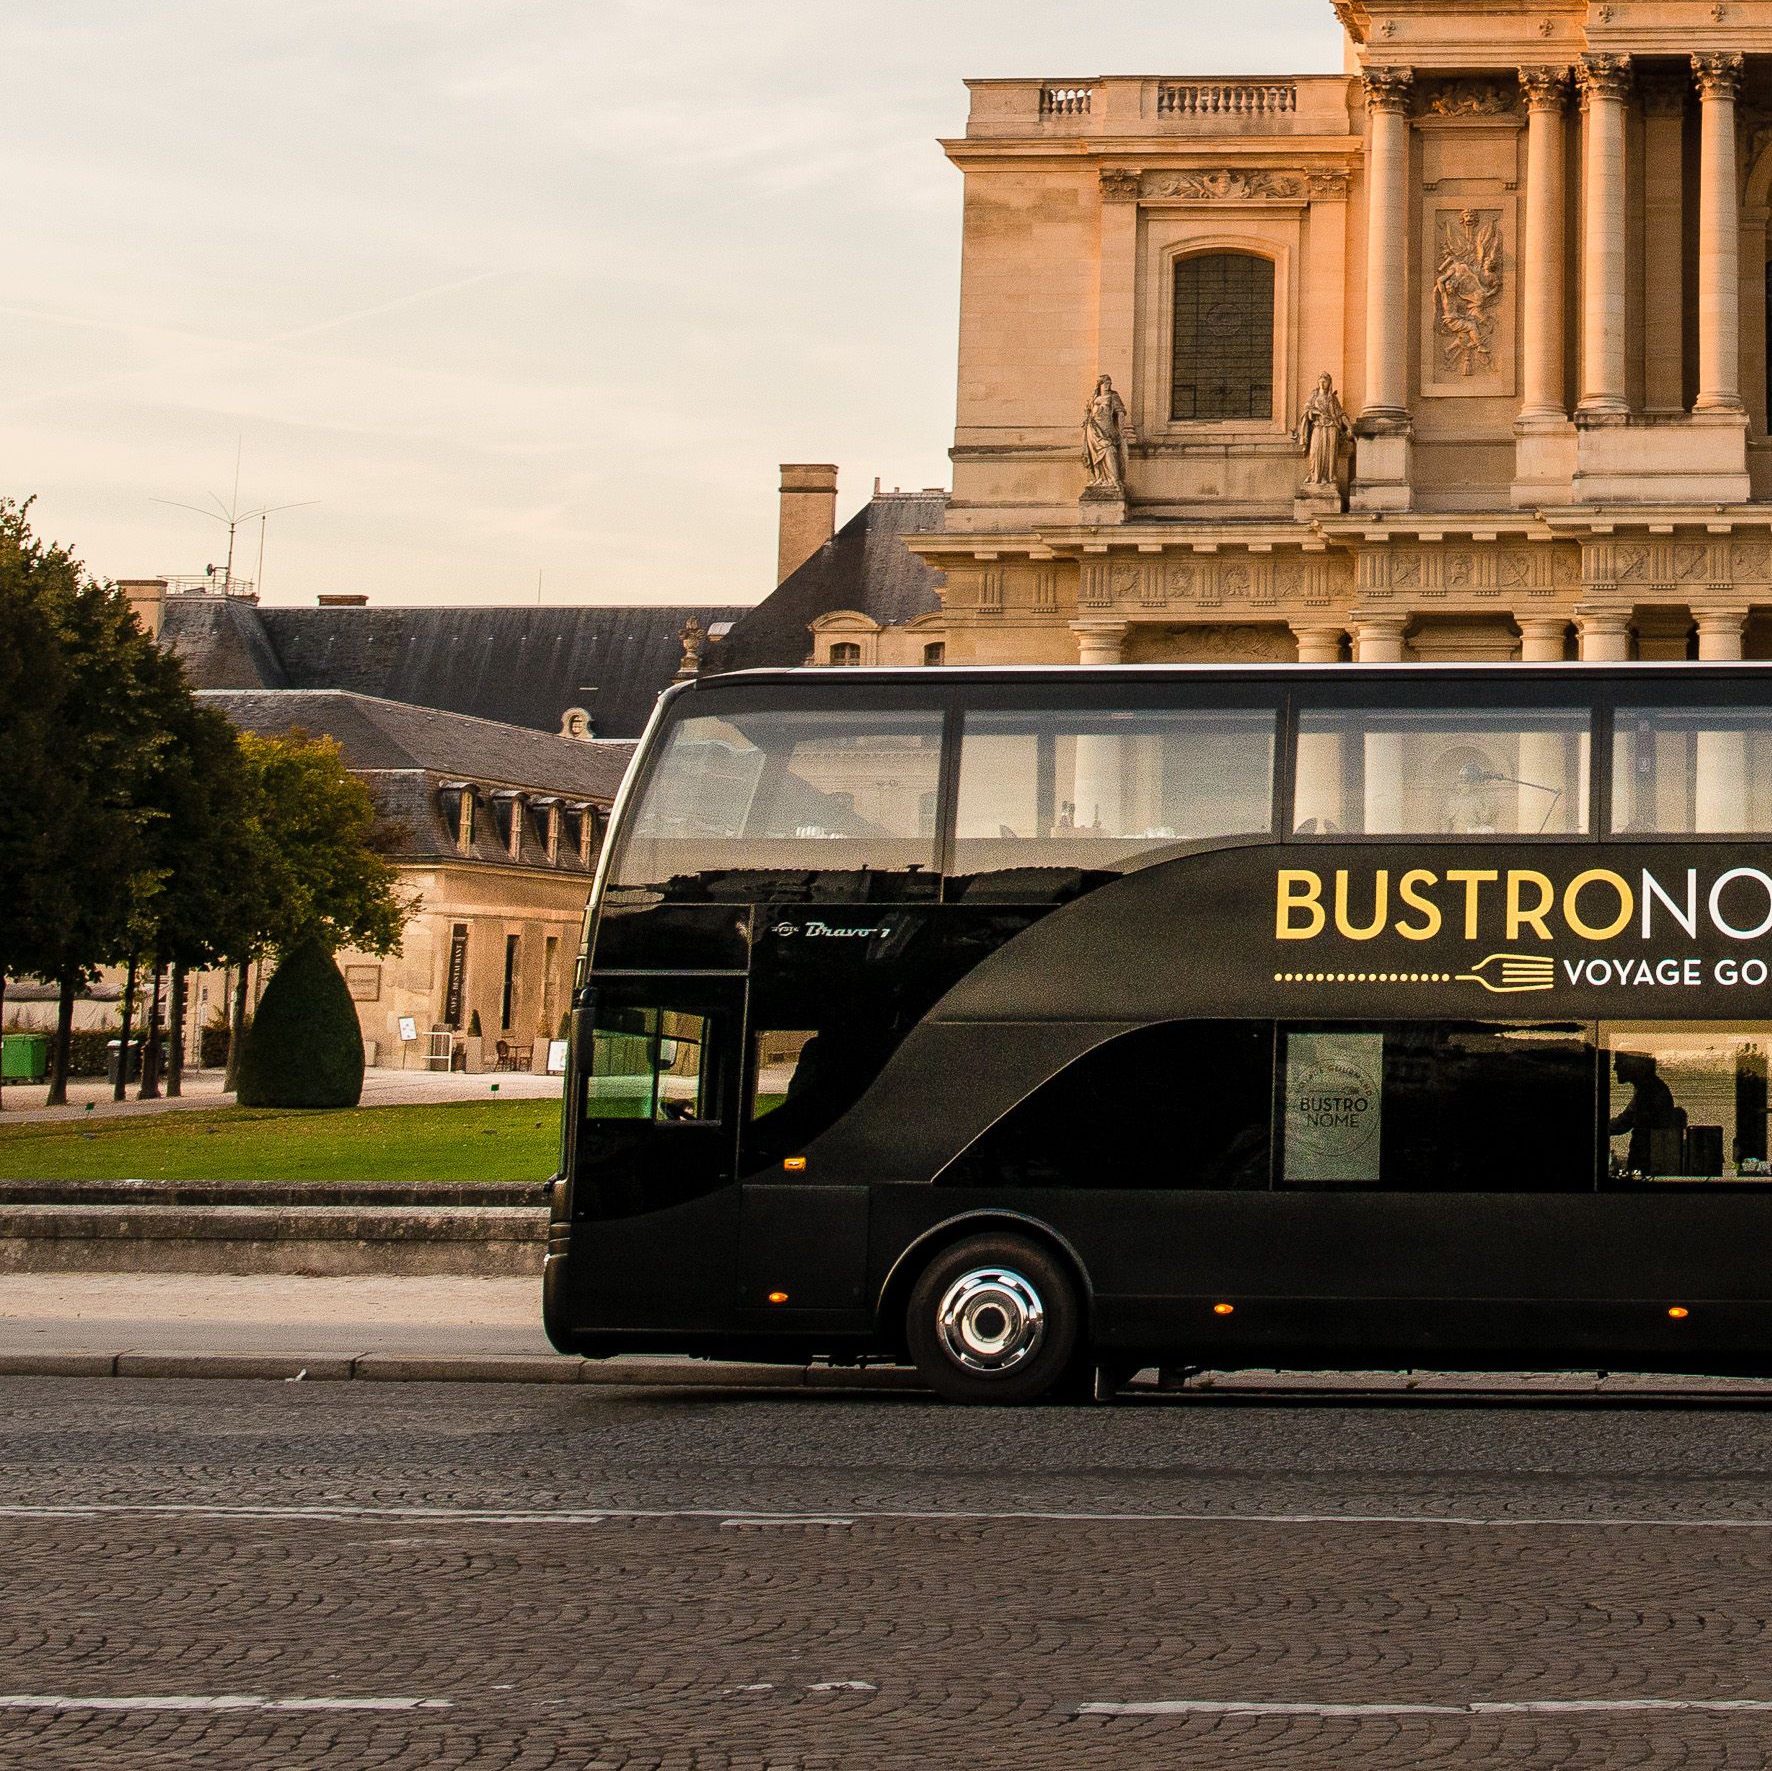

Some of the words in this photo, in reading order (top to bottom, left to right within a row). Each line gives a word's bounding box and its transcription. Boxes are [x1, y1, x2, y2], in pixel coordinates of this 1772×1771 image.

[805, 921, 878, 937] Bravo
[1562, 958, 1702, 986] VOYAGE
[1299, 1097, 1369, 1113] BUSTRO
[1306, 1113, 1360, 1129] NOME
